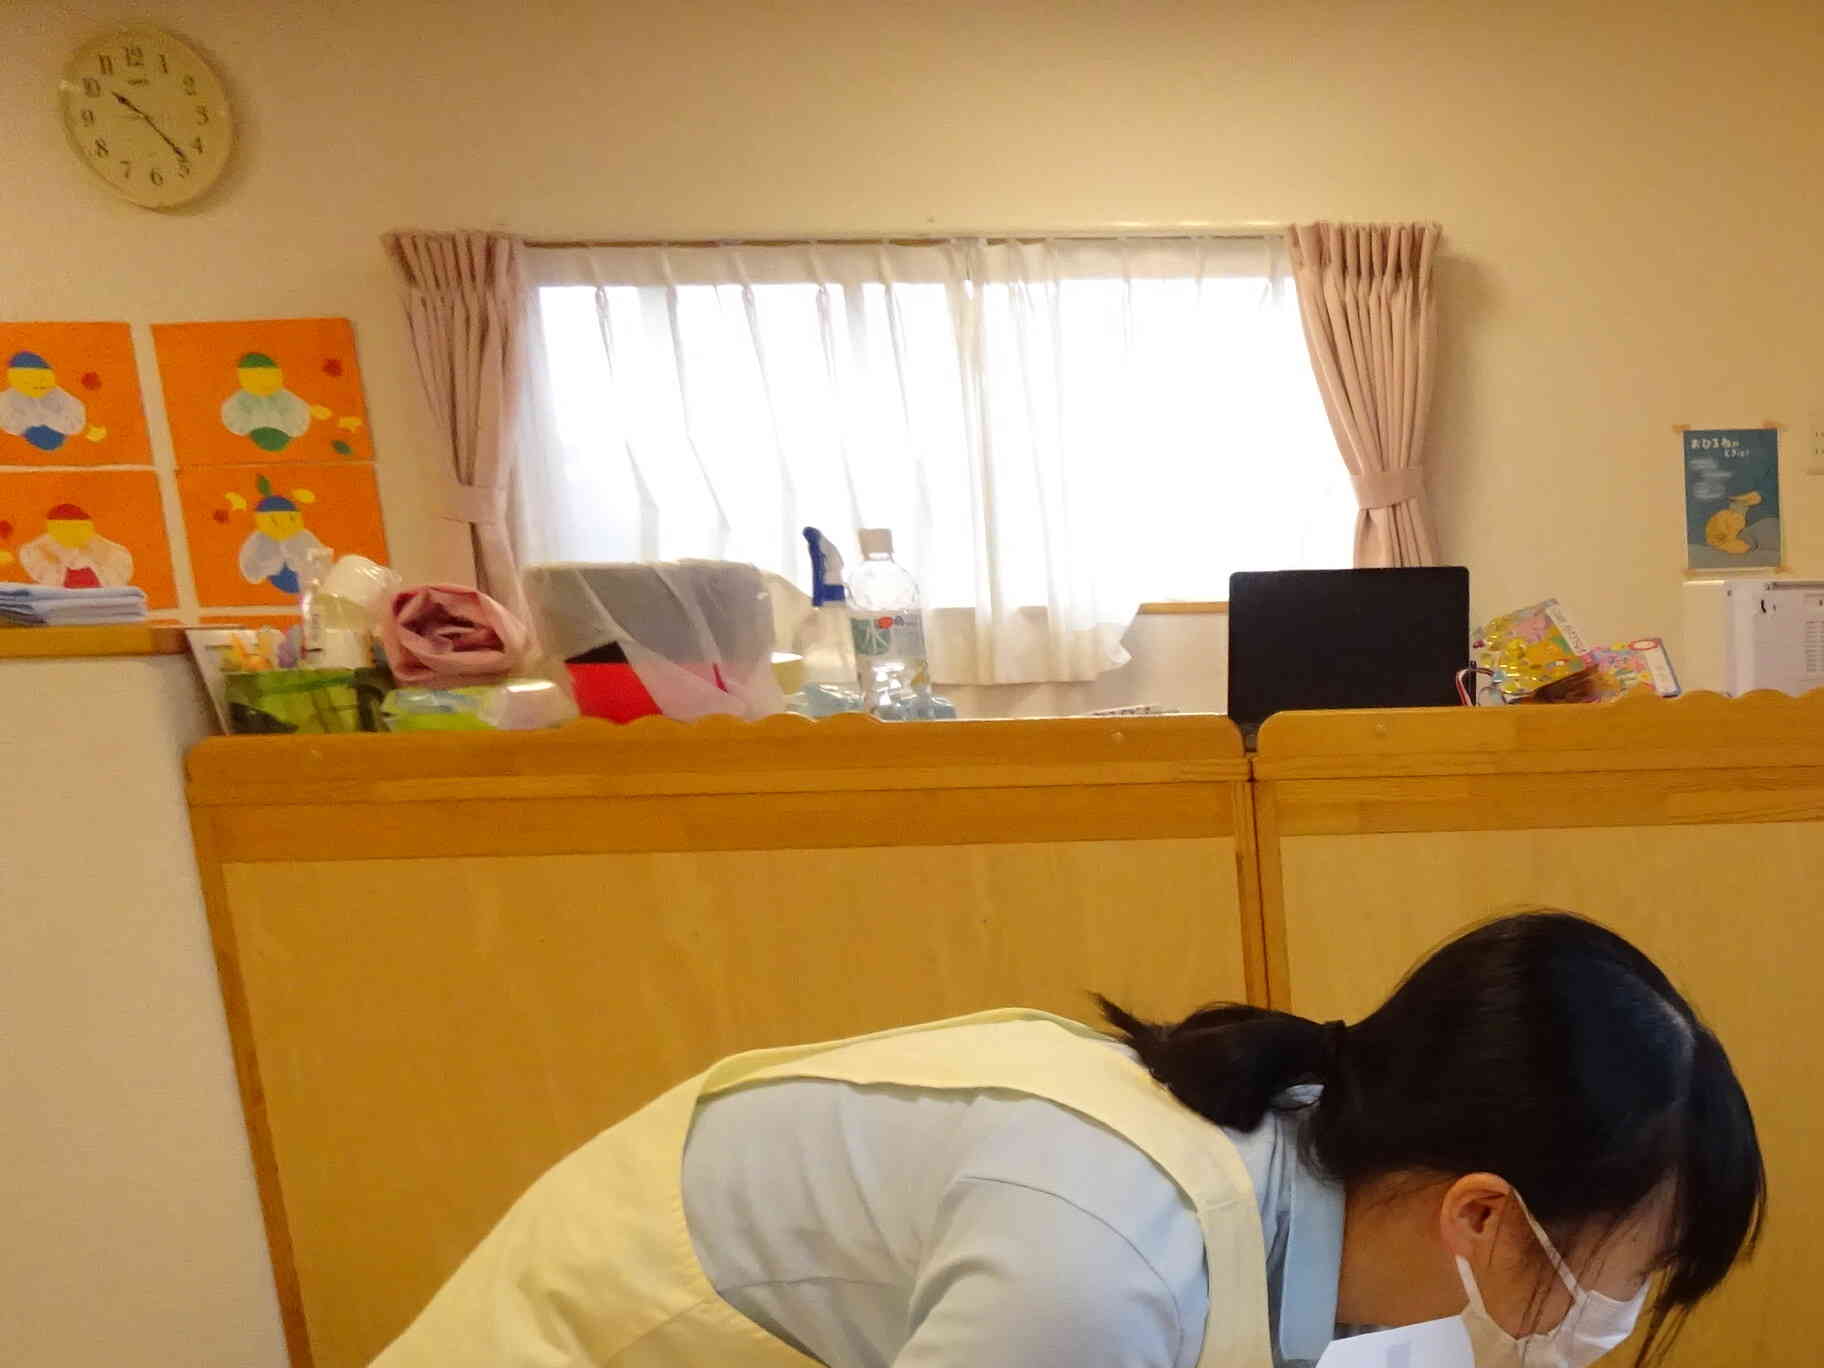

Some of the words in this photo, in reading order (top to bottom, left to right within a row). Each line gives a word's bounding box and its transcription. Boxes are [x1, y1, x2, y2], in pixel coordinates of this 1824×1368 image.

[99, 54, 113, 75] 11
[125, 47, 144, 67] 12
[160, 54, 168, 74] 1
[82, 78, 101, 98] 10
[183, 75, 197, 96] 2
[81, 109, 95, 127] 9
[196, 104, 209, 126] 3
[95, 137, 109, 157] 8
[192, 136, 203, 154] 4
[120, 160, 131, 179] 7
[150, 168, 164, 186] 6
